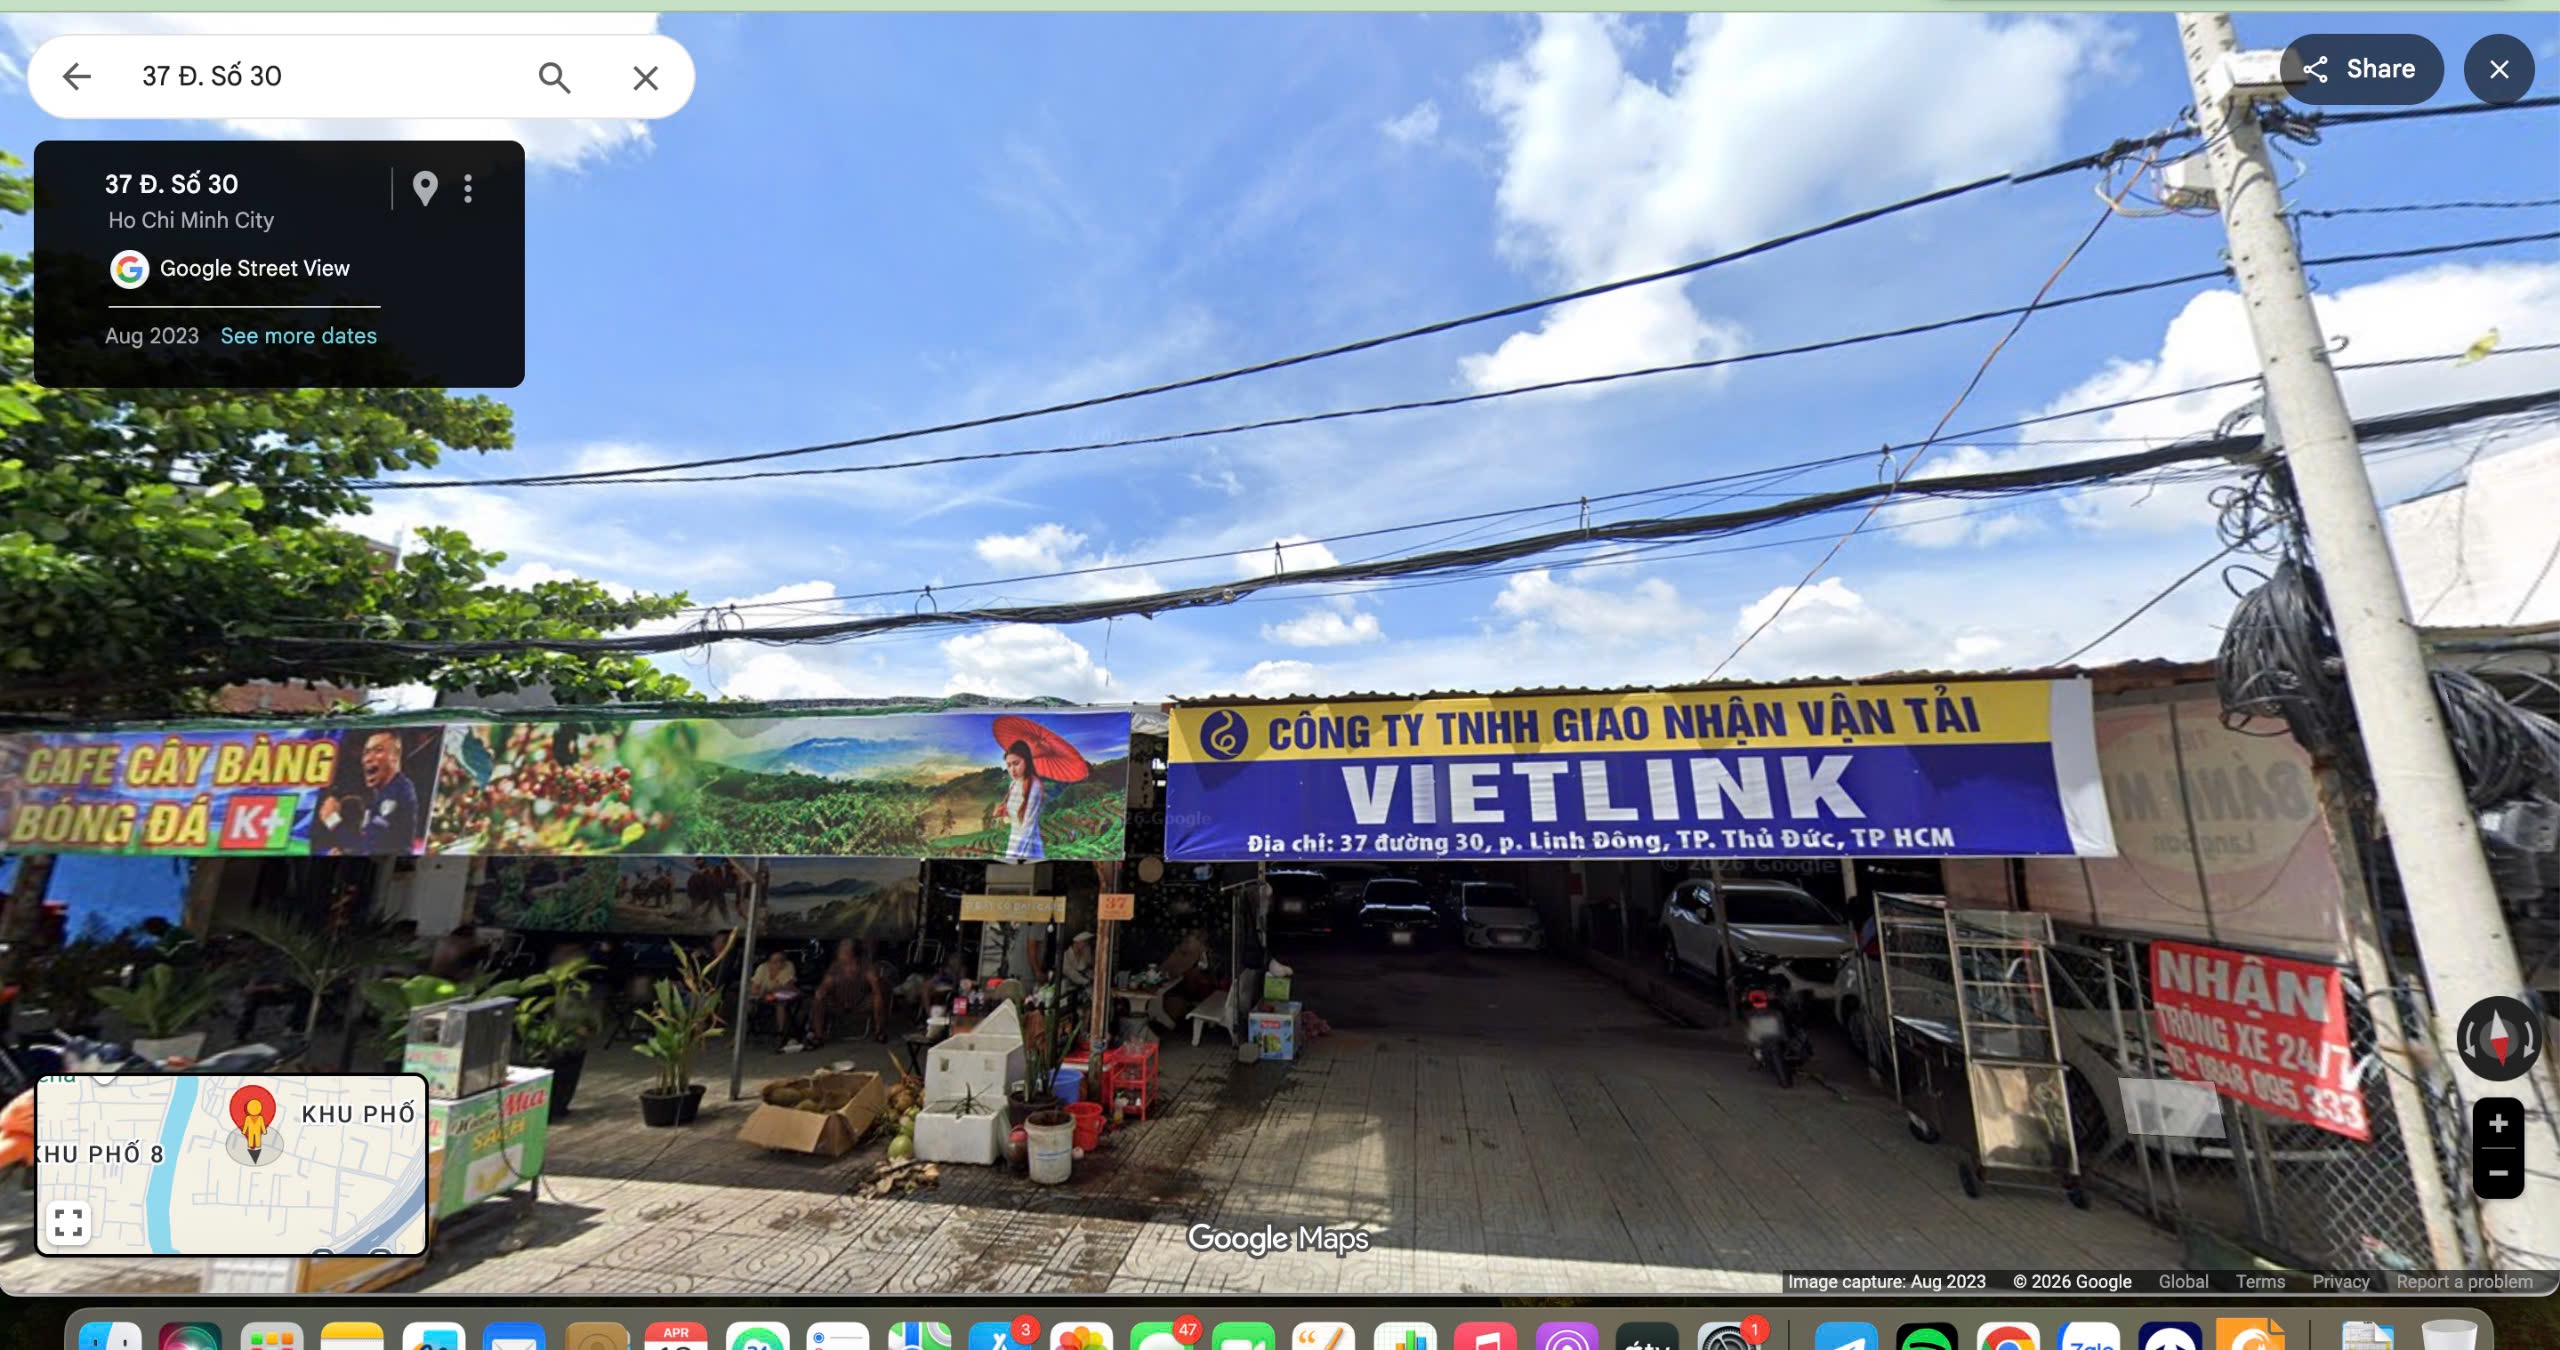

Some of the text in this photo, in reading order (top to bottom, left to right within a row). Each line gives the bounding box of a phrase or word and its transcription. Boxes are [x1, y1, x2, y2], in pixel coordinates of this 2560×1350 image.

[1268, 684, 1982, 751] CÔNG TY TNHH GIAO NHẬN VẬN TẢI
[24, 746, 120, 787] CAFE
[126, 735, 210, 788] CÂY
[1341, 754, 1867, 825] VIETLINK
[10, 797, 138, 846] BÓNG
[145, 793, 210, 846] ĐÁ
[1247, 827, 1956, 858] Địa chỉ: 37 đường 30, p. Linh Đông, TP. Thủ Đức, TP HCM
[1104, 895, 1129, 910] 37
[2157, 950, 2330, 1023] NHẬN
[2234, 1021, 2273, 1065] XE
[2303, 1084, 2367, 1131] 333
